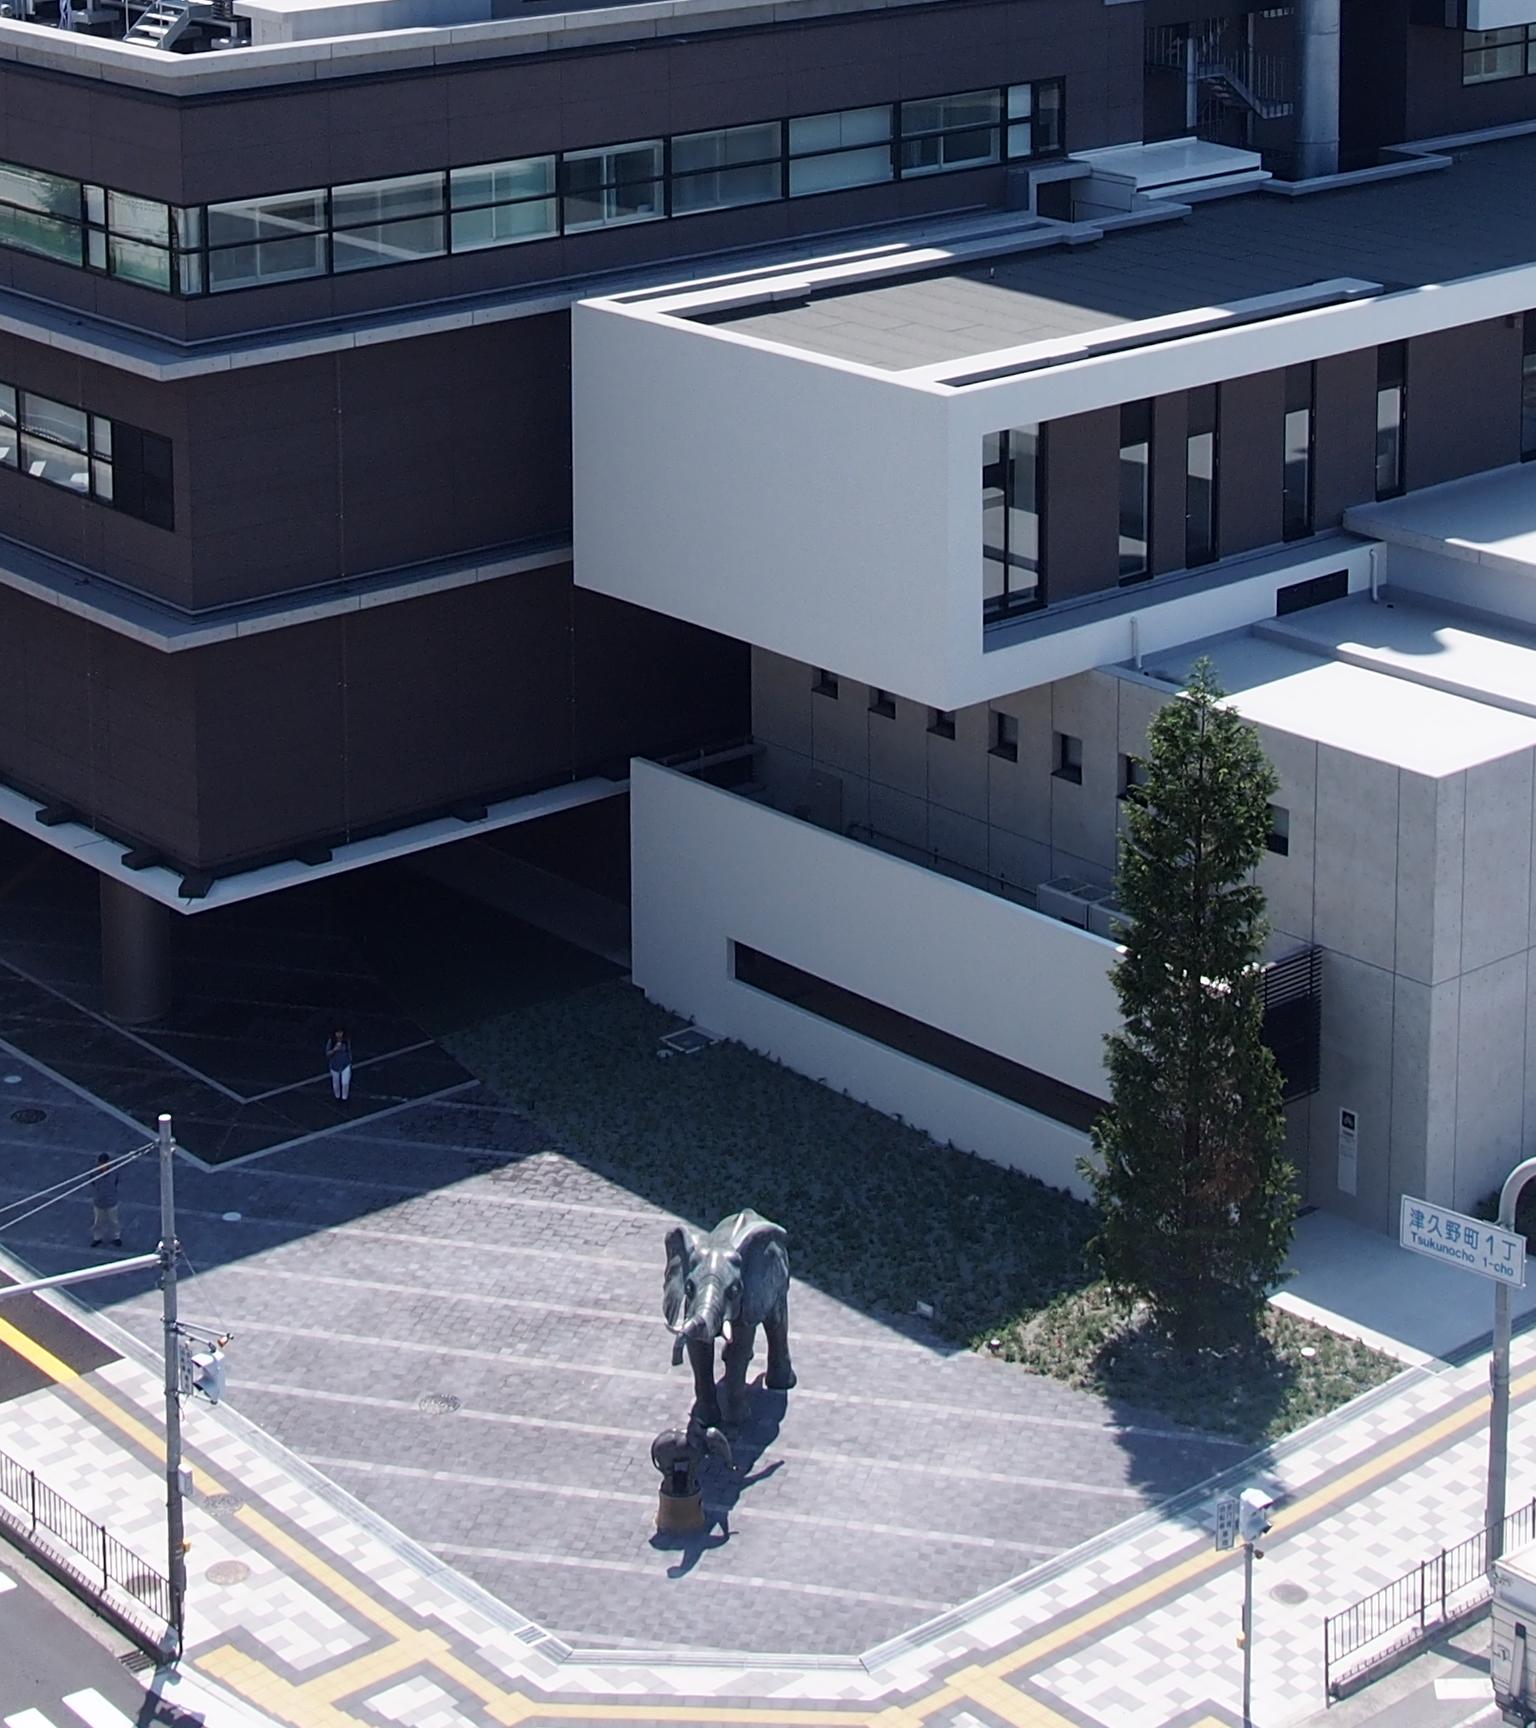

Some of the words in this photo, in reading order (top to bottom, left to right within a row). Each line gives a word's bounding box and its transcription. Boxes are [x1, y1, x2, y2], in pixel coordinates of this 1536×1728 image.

[1409, 1207, 1517, 1262] 津久野町1丁
[1411, 1231, 1475, 1263] Tsukunocho
[1483, 1257, 1514, 1277] 1-cho
